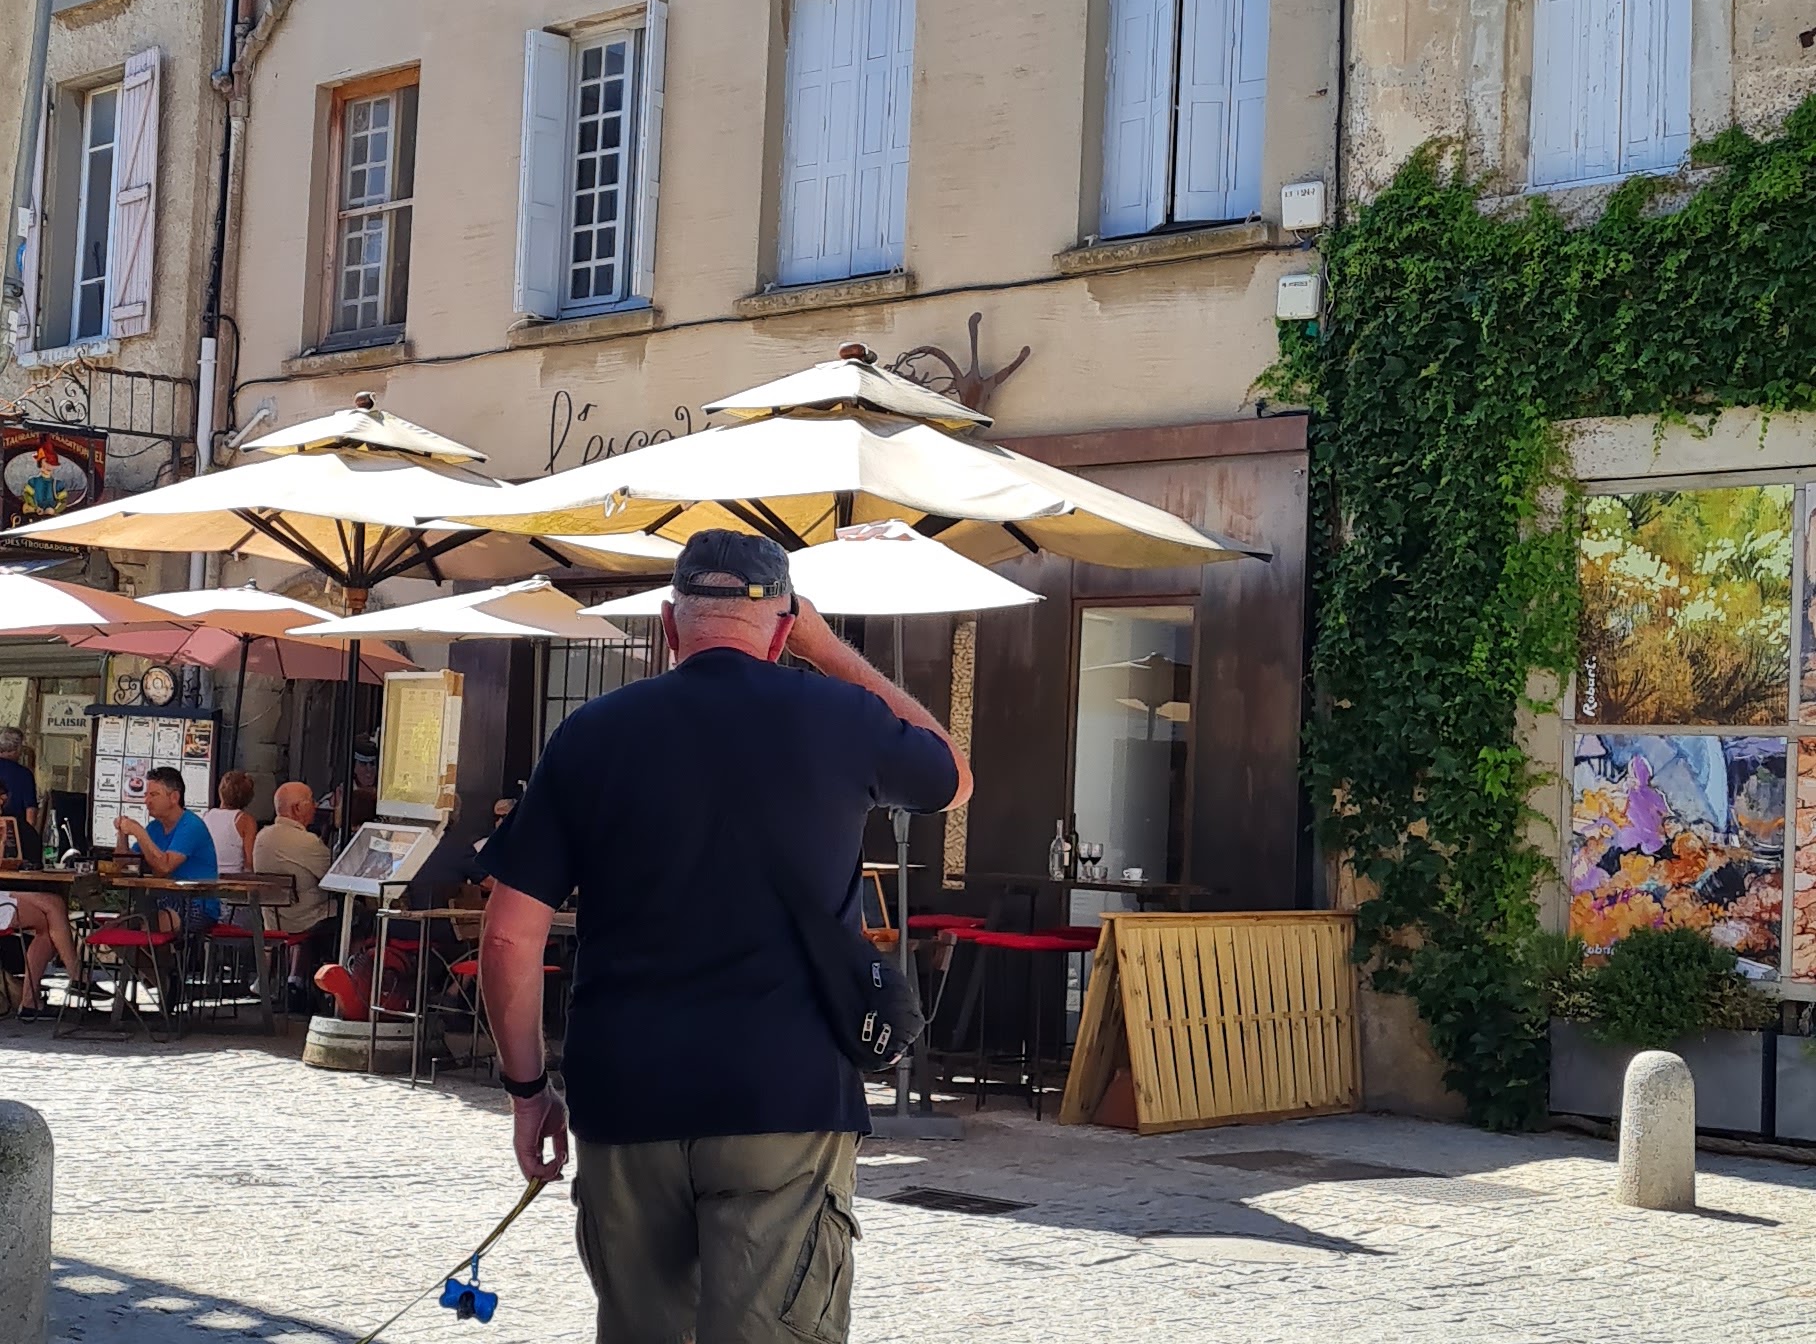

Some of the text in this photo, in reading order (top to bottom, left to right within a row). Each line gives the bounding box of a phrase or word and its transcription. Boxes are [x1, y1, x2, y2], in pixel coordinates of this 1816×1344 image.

[51, 431, 104, 464] TRADITIONEL
[21, 538, 81, 554] TROUBADOURS
[47, 717, 87, 728] PLAISIR
